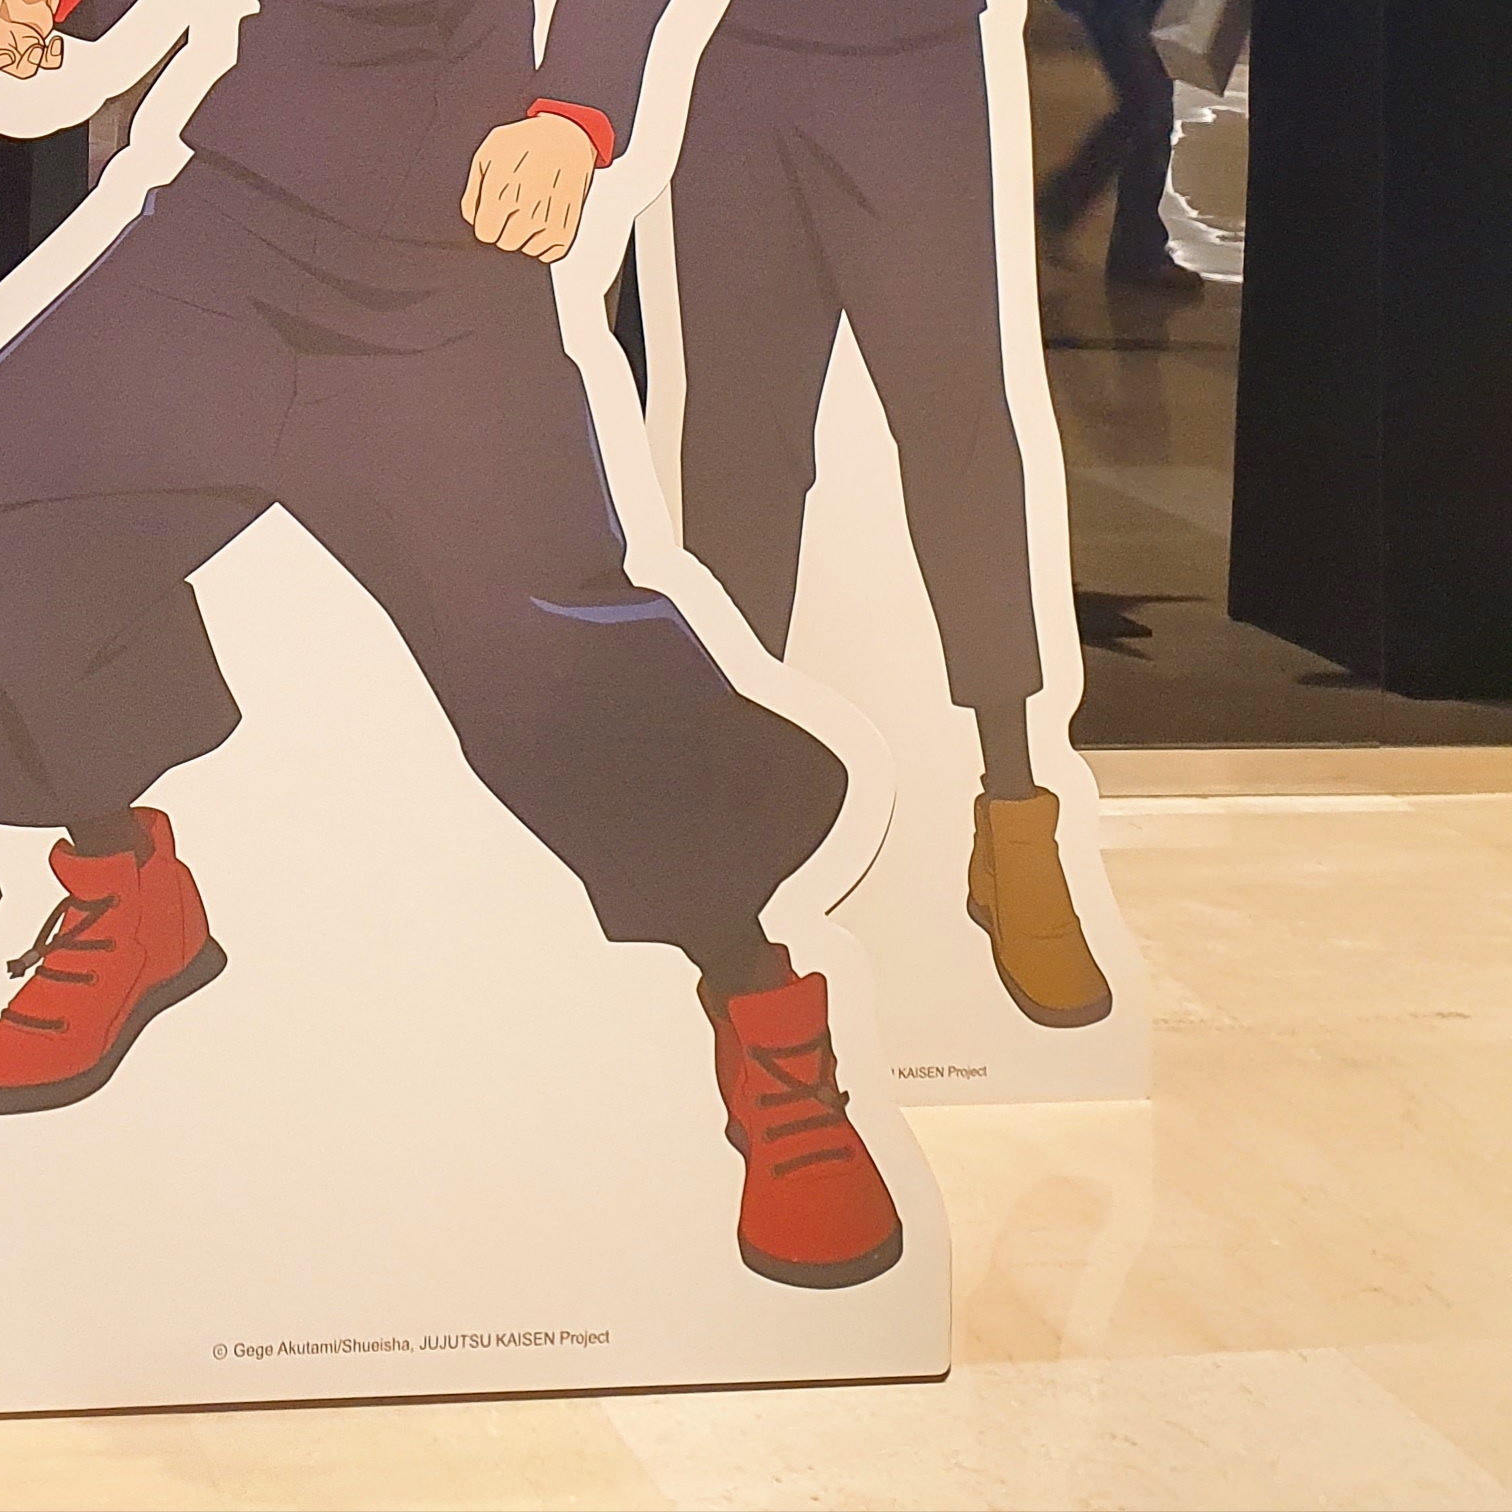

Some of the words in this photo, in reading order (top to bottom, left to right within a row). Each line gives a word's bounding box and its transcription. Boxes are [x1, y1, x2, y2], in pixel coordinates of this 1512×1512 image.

[898, 1066, 945, 1080] KAISEN
[948, 1065, 988, 1080] Project
[233, 1342, 274, 1359] Gege
[277, 1336, 414, 1356] Akutami/Shueisha,
[419, 1333, 492, 1351] JUJUTSU
[496, 1331, 556, 1348] KAISEN
[559, 1329, 611, 1347] Project
